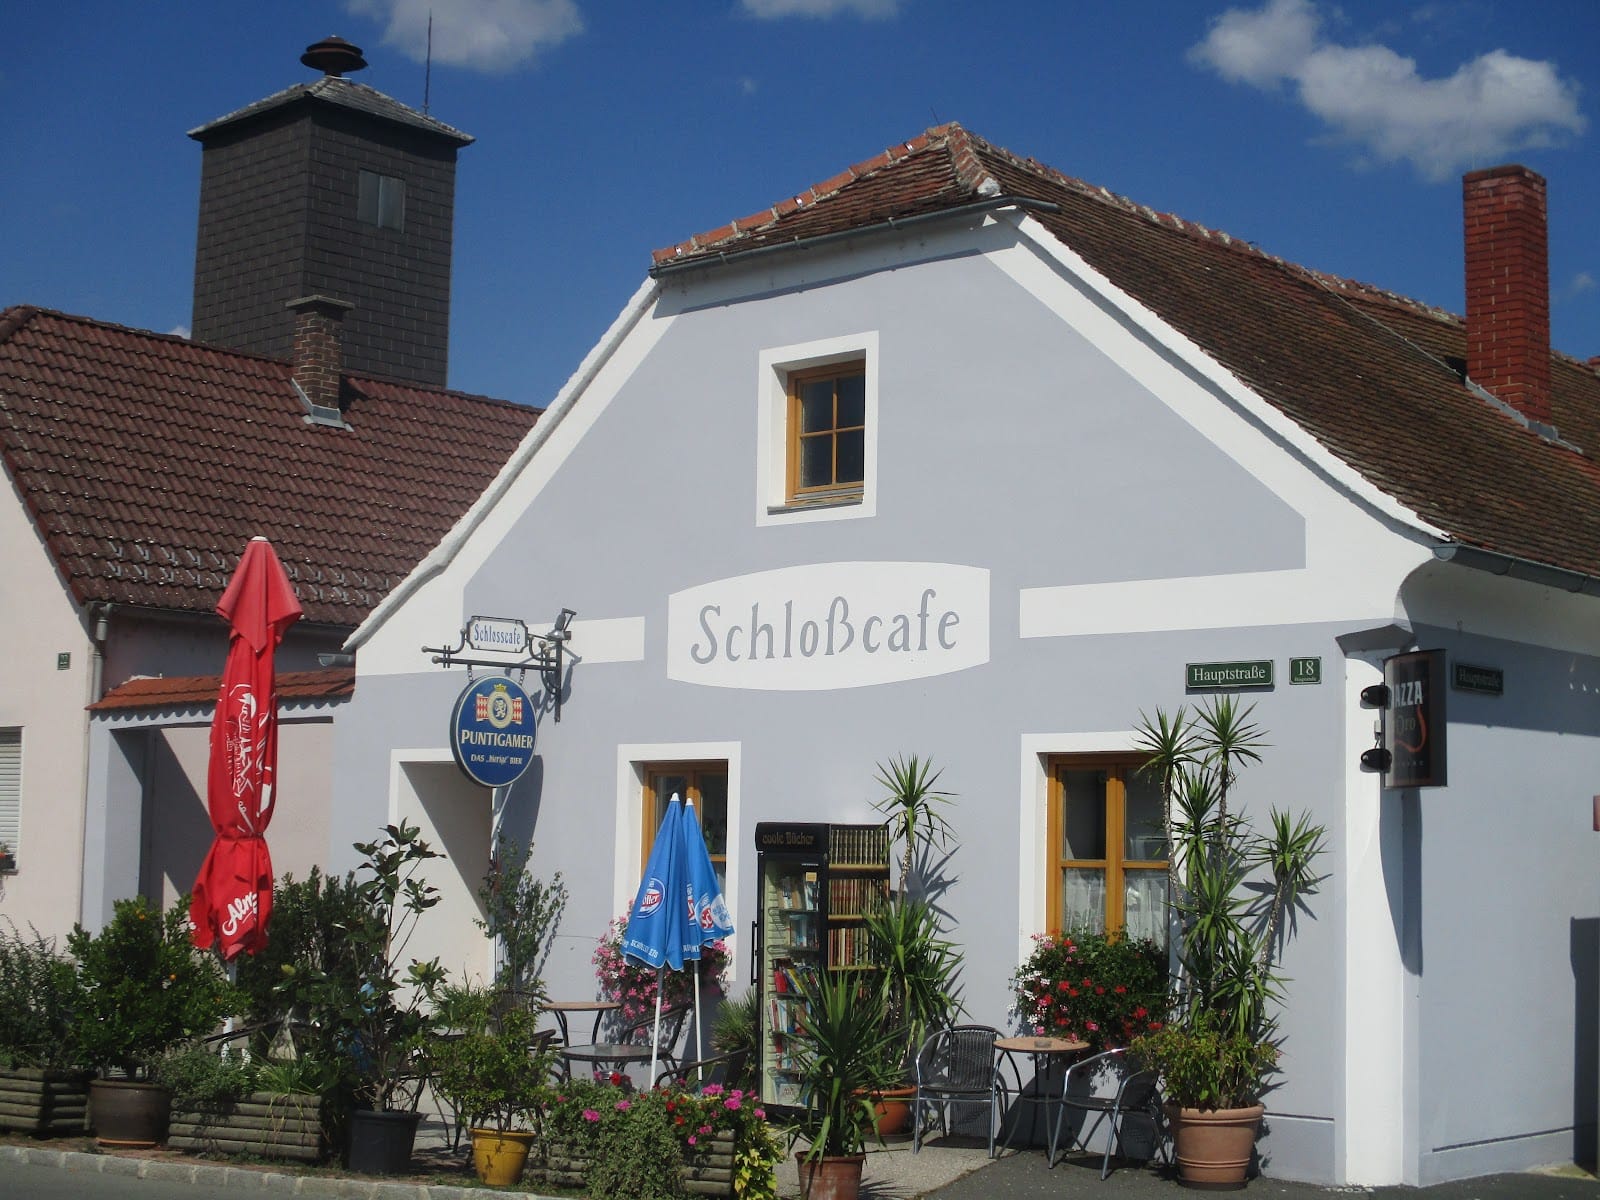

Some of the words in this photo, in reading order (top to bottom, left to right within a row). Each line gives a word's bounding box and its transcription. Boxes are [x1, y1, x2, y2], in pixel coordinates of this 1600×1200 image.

[474, 623, 521, 645] Schlosscafe
[690, 588, 960, 665] Schloßcafe
[1194, 665, 1266, 685] Hauptstraße
[1297, 660, 1314, 676] 18
[461, 729, 533, 749] PUNTIGAMER
[471, 753, 485, 762] DAS
